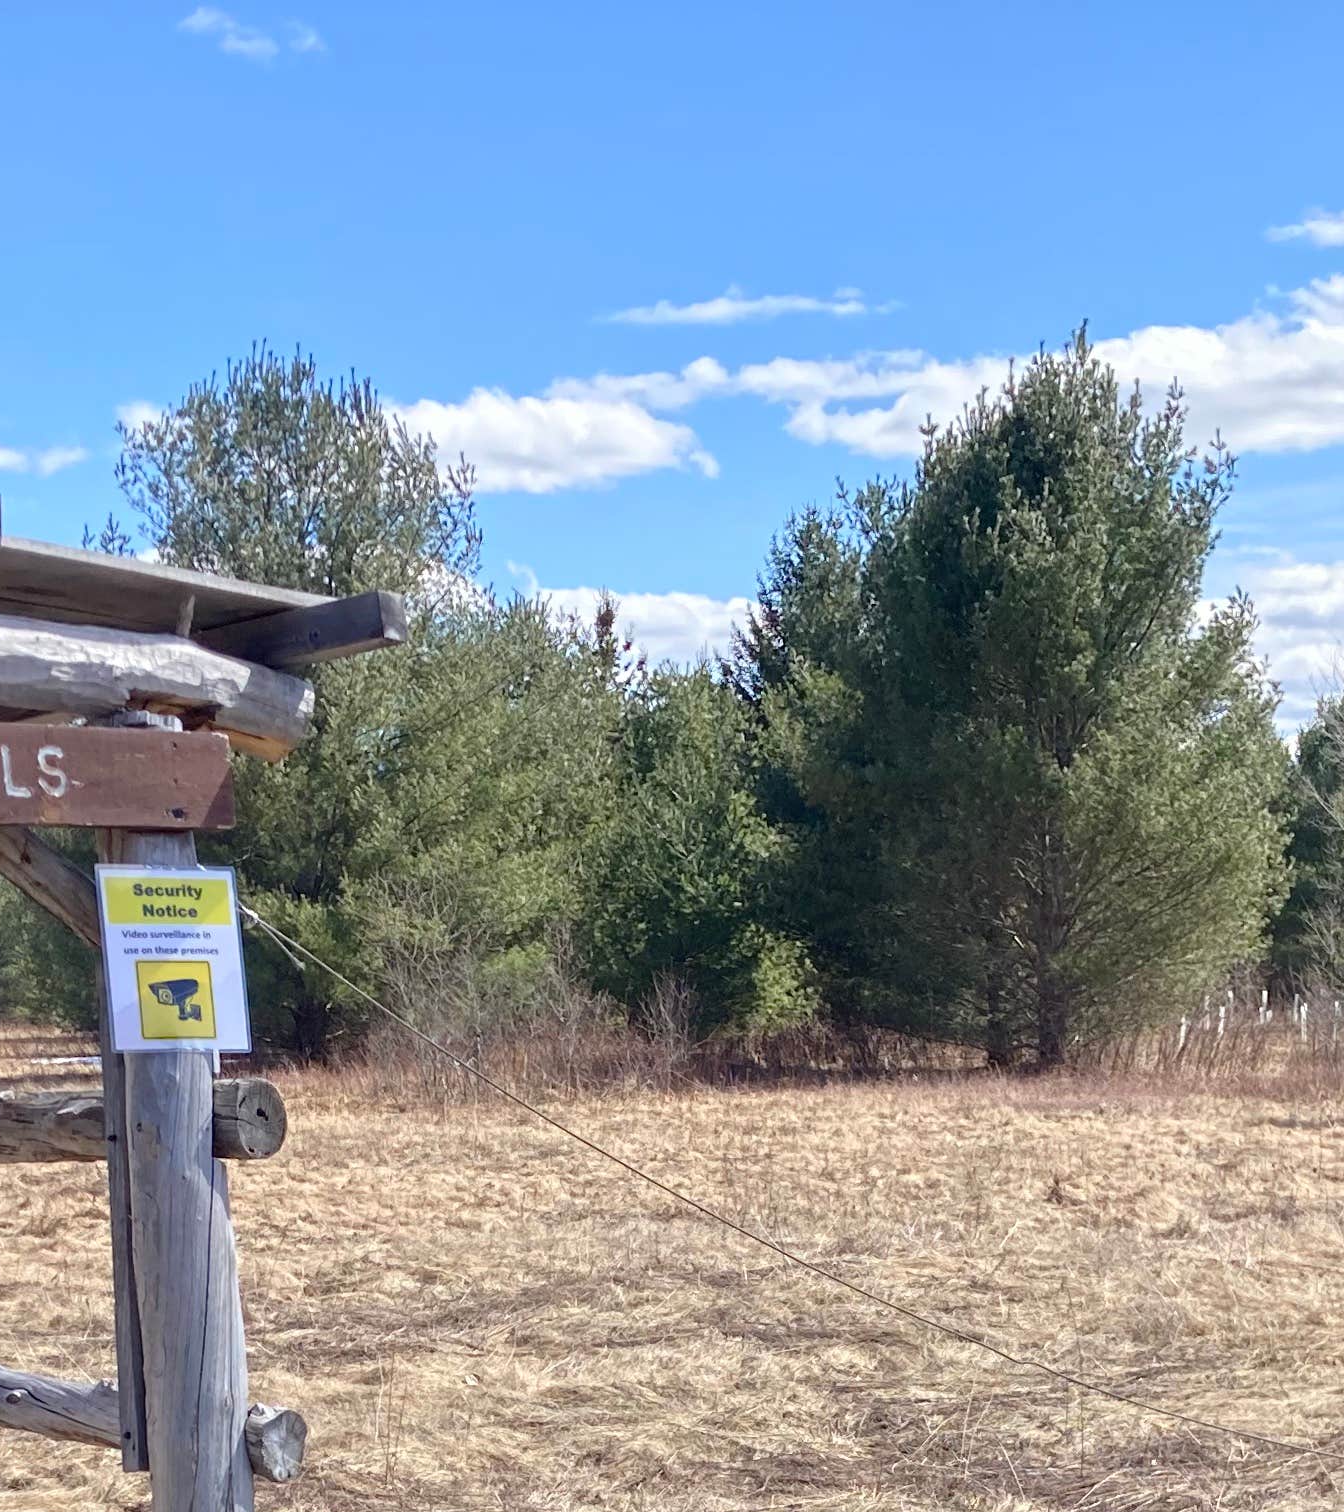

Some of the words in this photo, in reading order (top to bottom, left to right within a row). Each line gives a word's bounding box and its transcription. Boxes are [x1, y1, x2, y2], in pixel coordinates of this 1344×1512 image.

[132, 883, 203, 901] Security
[142, 903, 198, 918] Notice
[121, 929, 148, 939] Video
[149, 930, 201, 939] surveillance
[202, 931, 211, 939] in
[123, 946, 139, 954] use
[154, 945, 179, 955] these
[180, 946, 219, 956] premises
